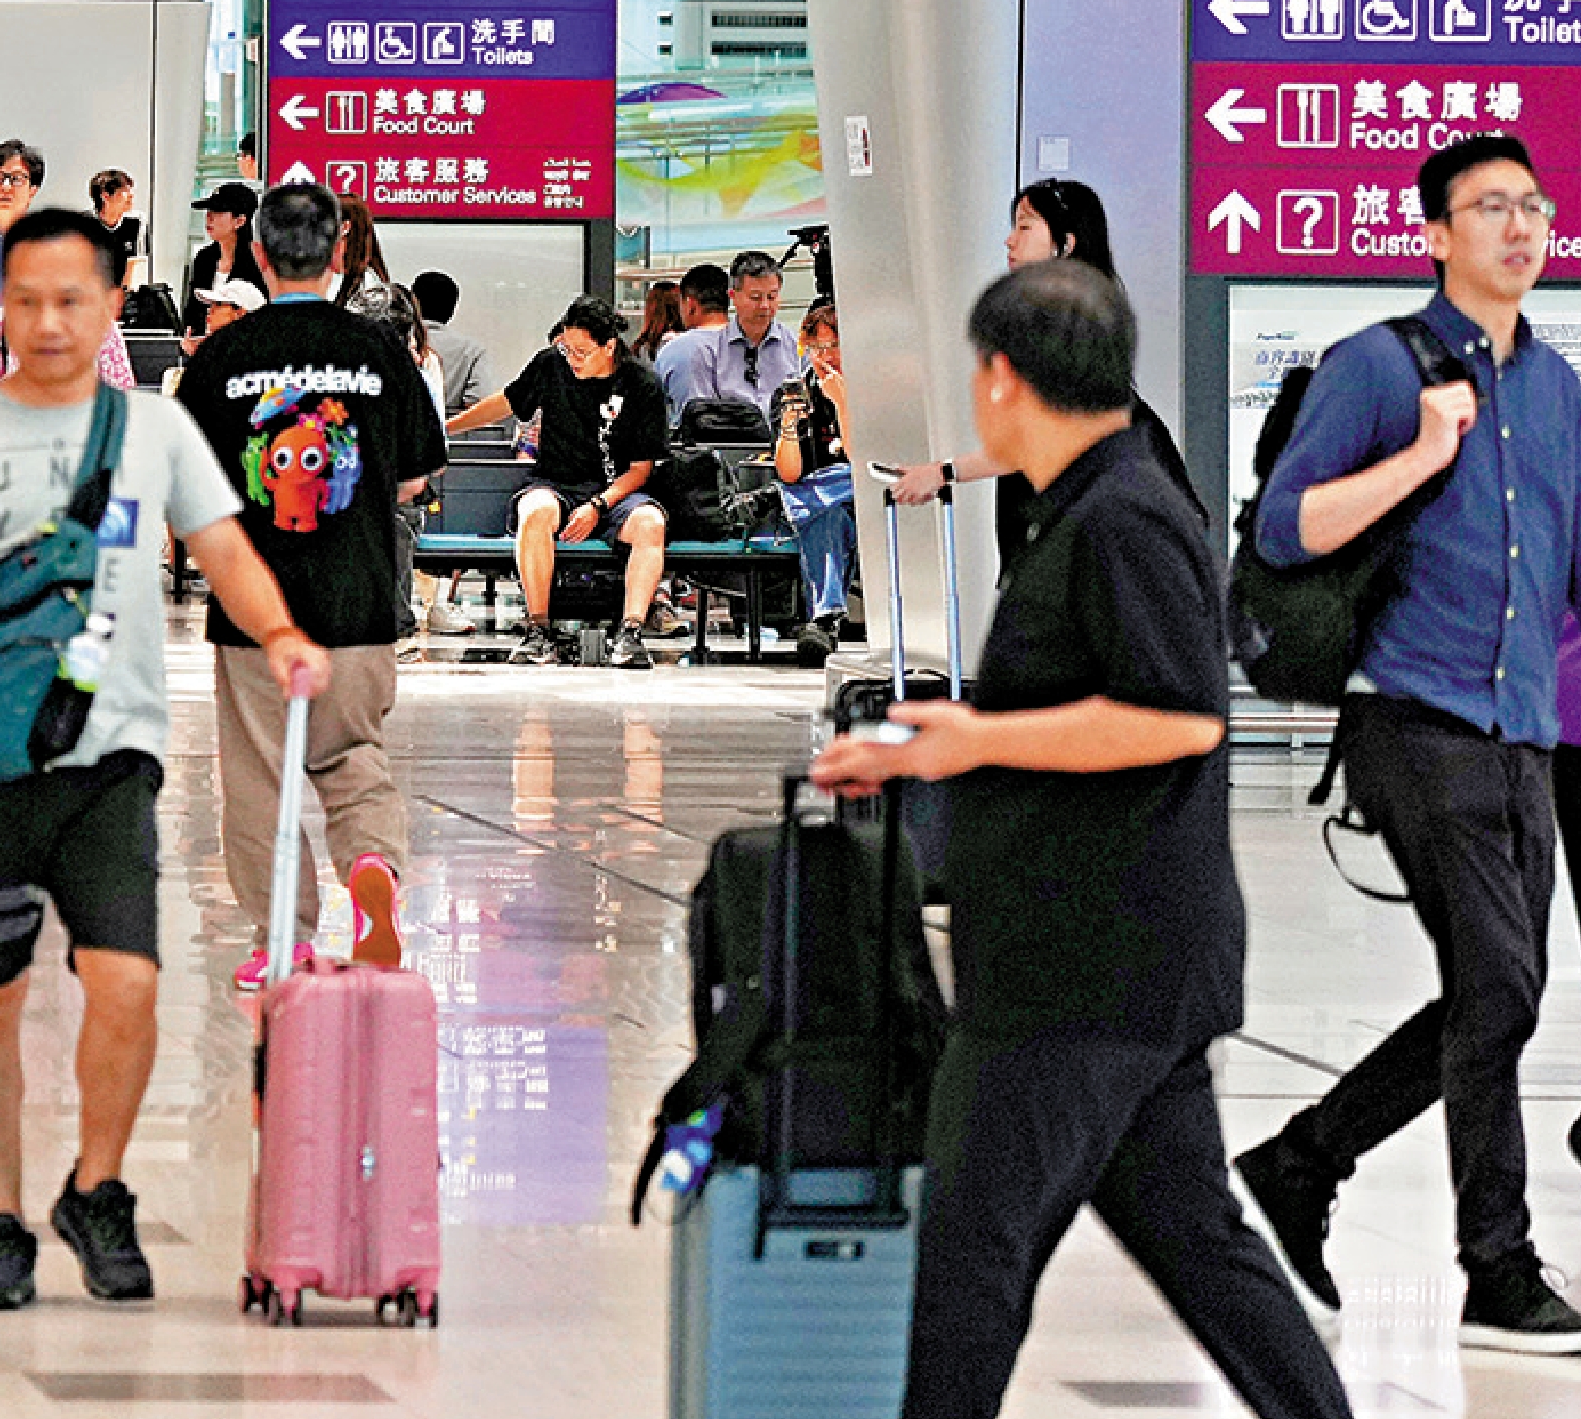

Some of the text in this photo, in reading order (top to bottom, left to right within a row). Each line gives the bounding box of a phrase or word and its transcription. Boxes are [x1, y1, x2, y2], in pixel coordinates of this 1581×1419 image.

[471, 17, 555, 45] 洗手間
[471, 46, 533, 66] Toilets
[1351, 79, 1523, 122] 美食廣場
[373, 116, 475, 136] Food Court
[1350, 122, 1419, 150] Food
[373, 185, 459, 204] Customer
[463, 185, 537, 204] Services
[225, 363, 382, 399] acmédelavie
